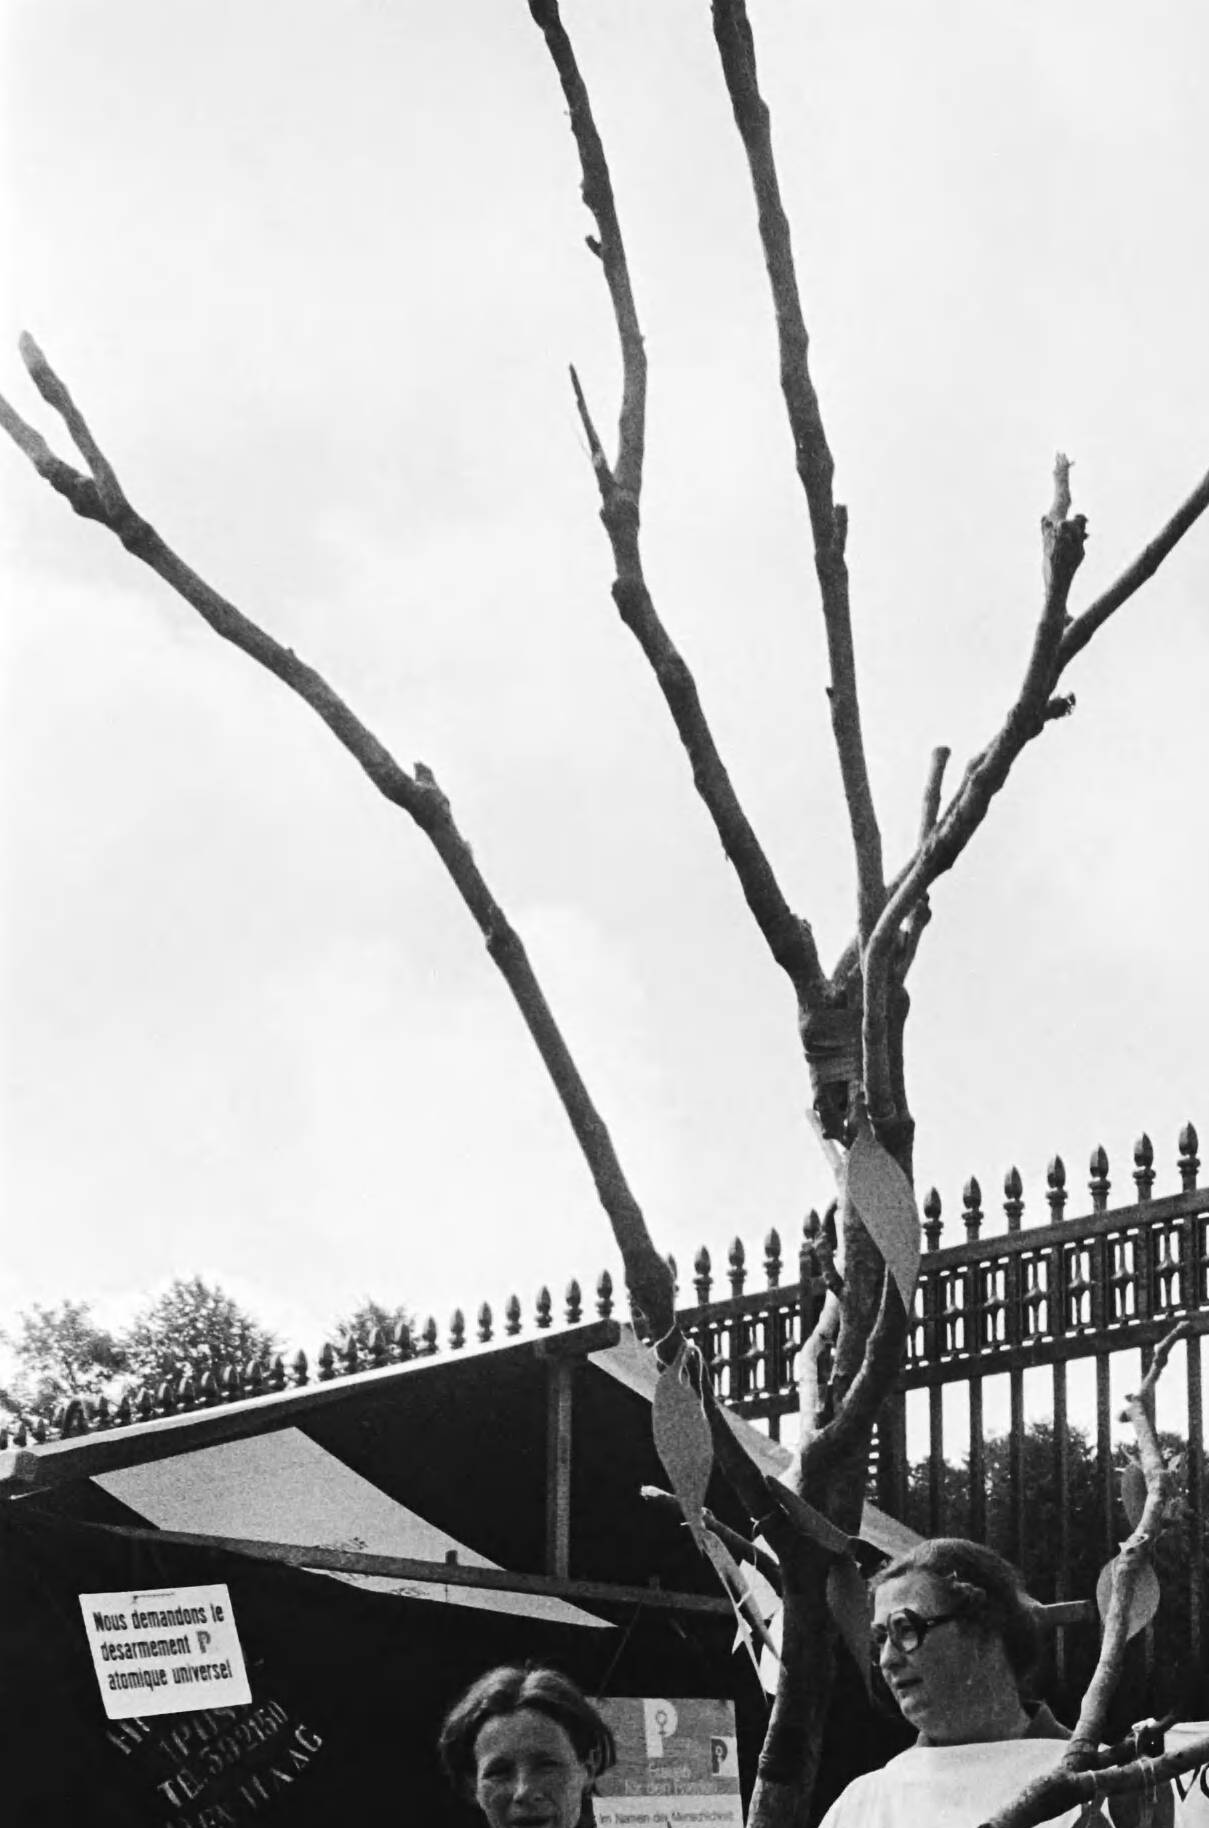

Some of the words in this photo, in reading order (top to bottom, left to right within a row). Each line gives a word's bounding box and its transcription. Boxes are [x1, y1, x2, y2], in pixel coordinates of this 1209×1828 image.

[93, 1610, 127, 1632] Nous
[131, 1604, 208, 1629] demandons
[210, 1603, 225, 1623] le
[101, 1634, 191, 1661] desarmement
[108, 1667, 168, 1691] atomique
[172, 1659, 233, 1685] universel
